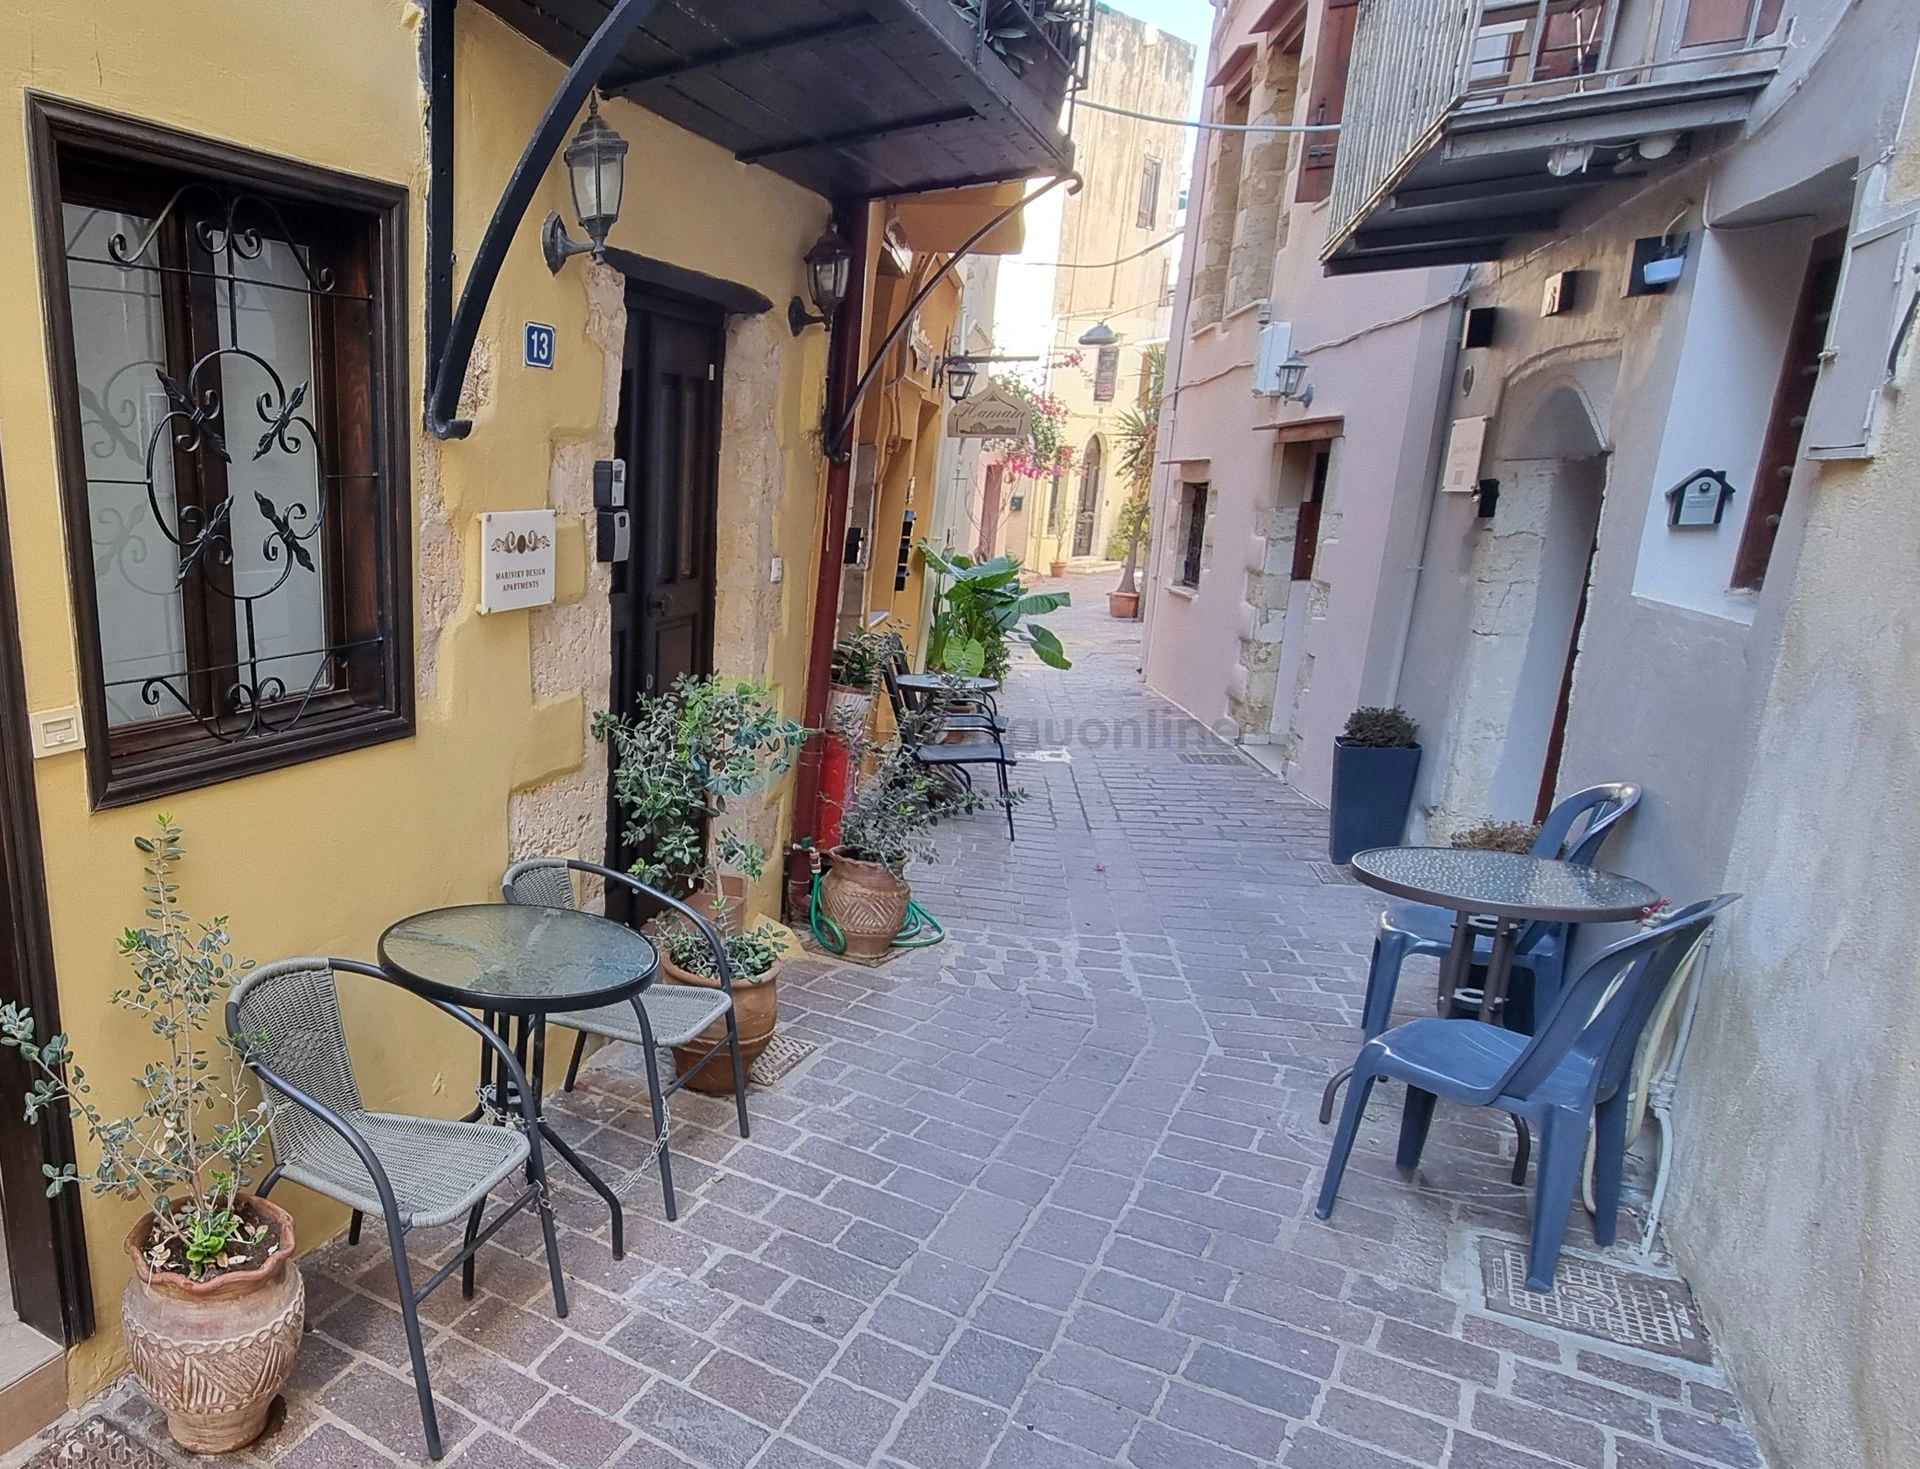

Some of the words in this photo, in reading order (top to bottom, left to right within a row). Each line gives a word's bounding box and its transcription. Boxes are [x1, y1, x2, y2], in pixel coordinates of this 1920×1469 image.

[531, 331, 548, 360] 13
[526, 568, 546, 577] DESIGN
[503, 580, 540, 591] APARTMENTS
